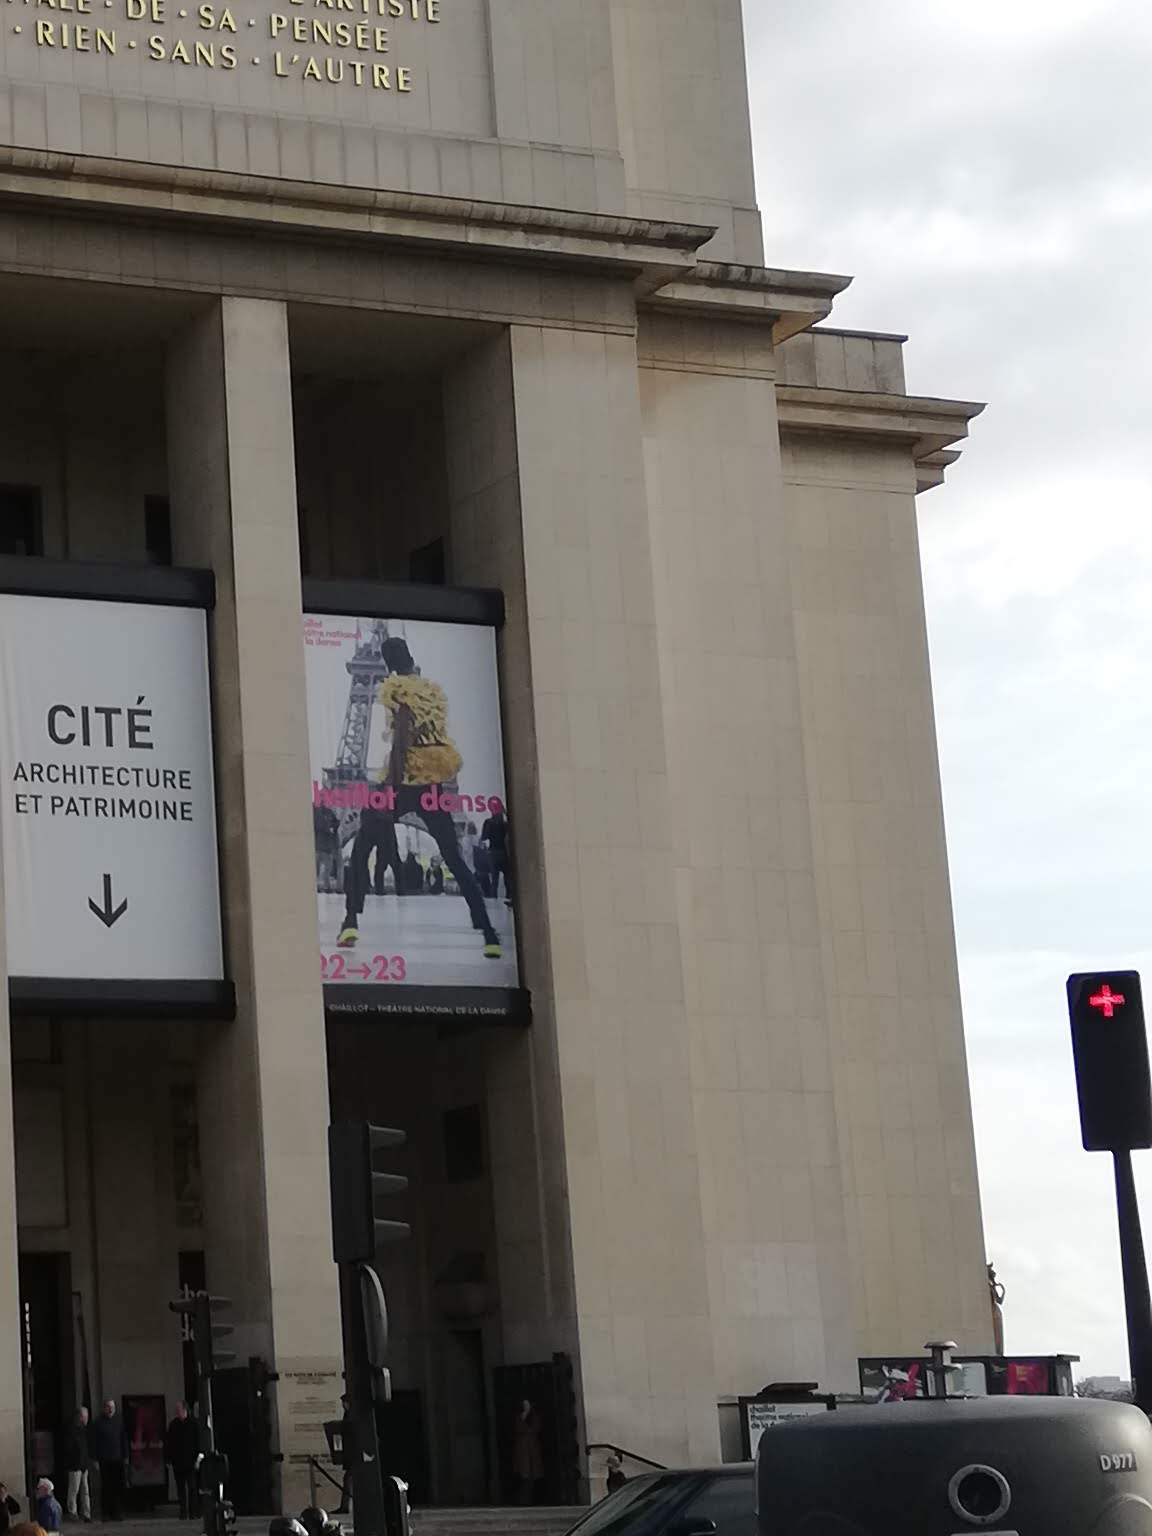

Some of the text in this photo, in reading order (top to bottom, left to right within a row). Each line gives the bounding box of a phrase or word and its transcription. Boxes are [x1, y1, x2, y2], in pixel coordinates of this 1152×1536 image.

[199, 4, 238, 33] SA
[270, 13, 390, 53] PENSÉE
[36, 20, 117, 56] RIEN
[148, 35, 238, 70] SANS
[275, 51, 414, 93] L'AUTRE
[48, 695, 154, 750] CITÉ
[13, 761, 193, 791] ARCHITECTURE
[15, 794, 194, 822] ET PATRIMOINE
[313, 780, 504, 815] haillot danse
[1100, 1452, 1133, 1471] D 977
